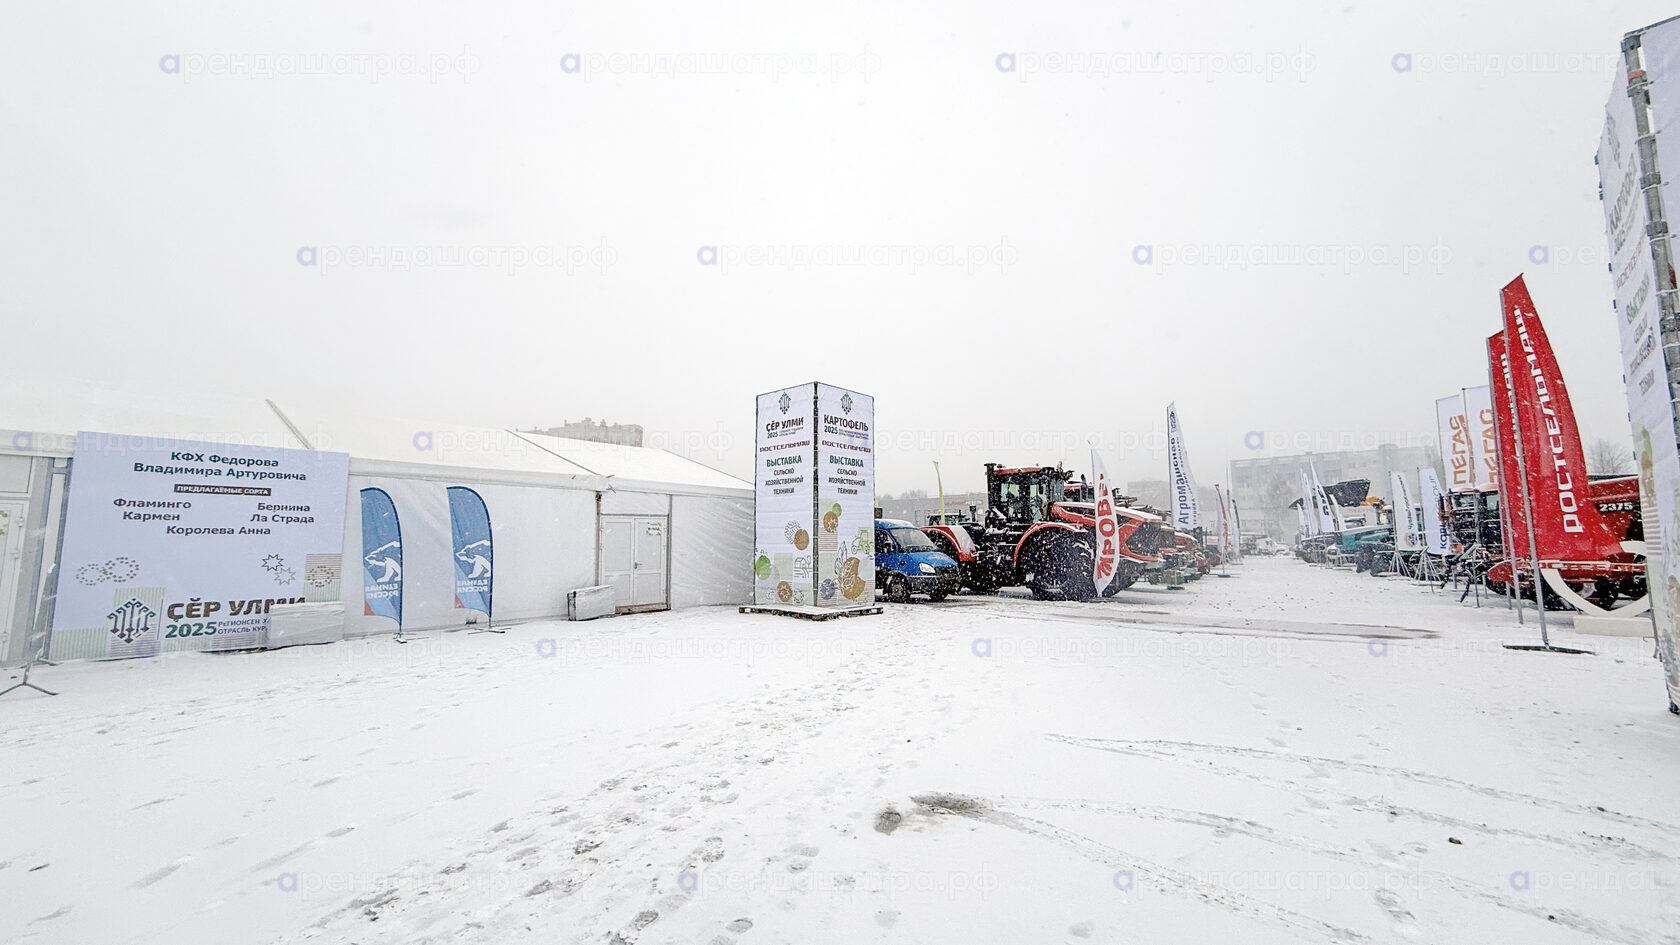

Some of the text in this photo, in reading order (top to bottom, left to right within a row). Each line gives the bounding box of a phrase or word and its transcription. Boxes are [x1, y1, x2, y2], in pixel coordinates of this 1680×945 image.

[782, 417, 804, 429] УЛМИ
[824, 414, 869, 431] КАРТОФЕЛЬ
[1514, 305, 1583, 533] РОСТСЕЛЬМАШ
[824, 425, 838, 435] 2025
[767, 432, 778, 440] 2025
[760, 440, 810, 452] РОСТСЕЛЬМАШ
[822, 440, 871, 453] РОСТСЕЛЬМАШ
[1449, 415, 1467, 484] ПЕГАС
[171, 452, 279, 468] КФХ Федорова
[766, 455, 802, 467] ВЫСТАВКА
[830, 455, 864, 467] ВЫСТАВКА
[133, 462, 306, 481] Владимира Артуровича
[774, 468, 794, 476] СЕЛЬСКО
[837, 468, 857, 476] СЕЛЬСКО
[177, 485, 242, 495] ПРЕДЛАГАЕМЫЕ
[773, 487, 794, 495] ТЕХНИКИ
[837, 487, 857, 495] ТЕХНИКИ
[113, 498, 192, 509] Фламинго
[257, 503, 311, 513] Бернина
[1600, 502, 1634, 512] 2375
[123, 511, 181, 522] Кармен
[250, 513, 315, 524] Ла Страда
[166, 526, 271, 536] Королева Анна
[228, 597, 305, 616] УЛ
[165, 621, 217, 638] 2025
[218, 626, 251, 635] ОТРАСЛЬ
